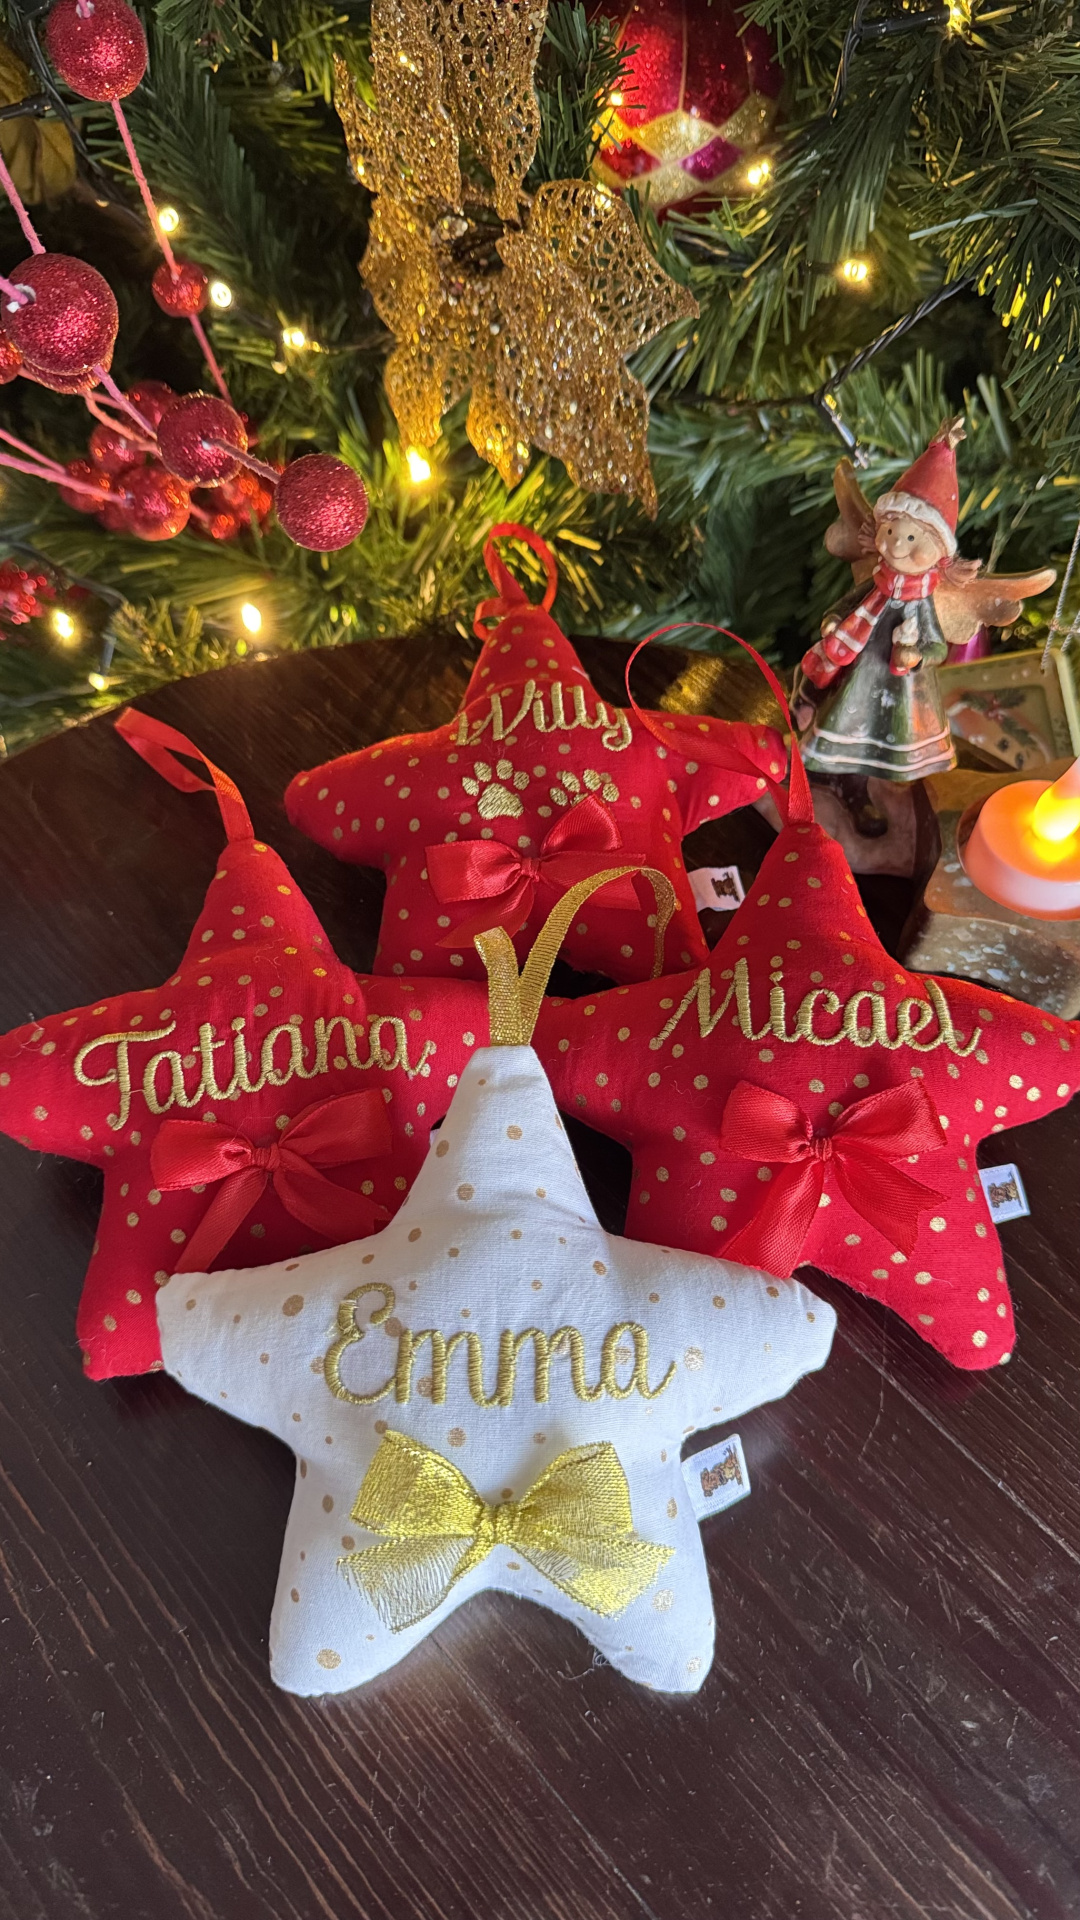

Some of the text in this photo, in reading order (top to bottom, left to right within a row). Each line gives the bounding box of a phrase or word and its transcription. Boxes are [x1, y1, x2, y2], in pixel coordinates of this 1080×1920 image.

[456, 679, 632, 751] Willy
[648, 957, 983, 1057] Micael
[74, 1015, 437, 1131] Tatiana
[323, 1281, 677, 1409] Emma
